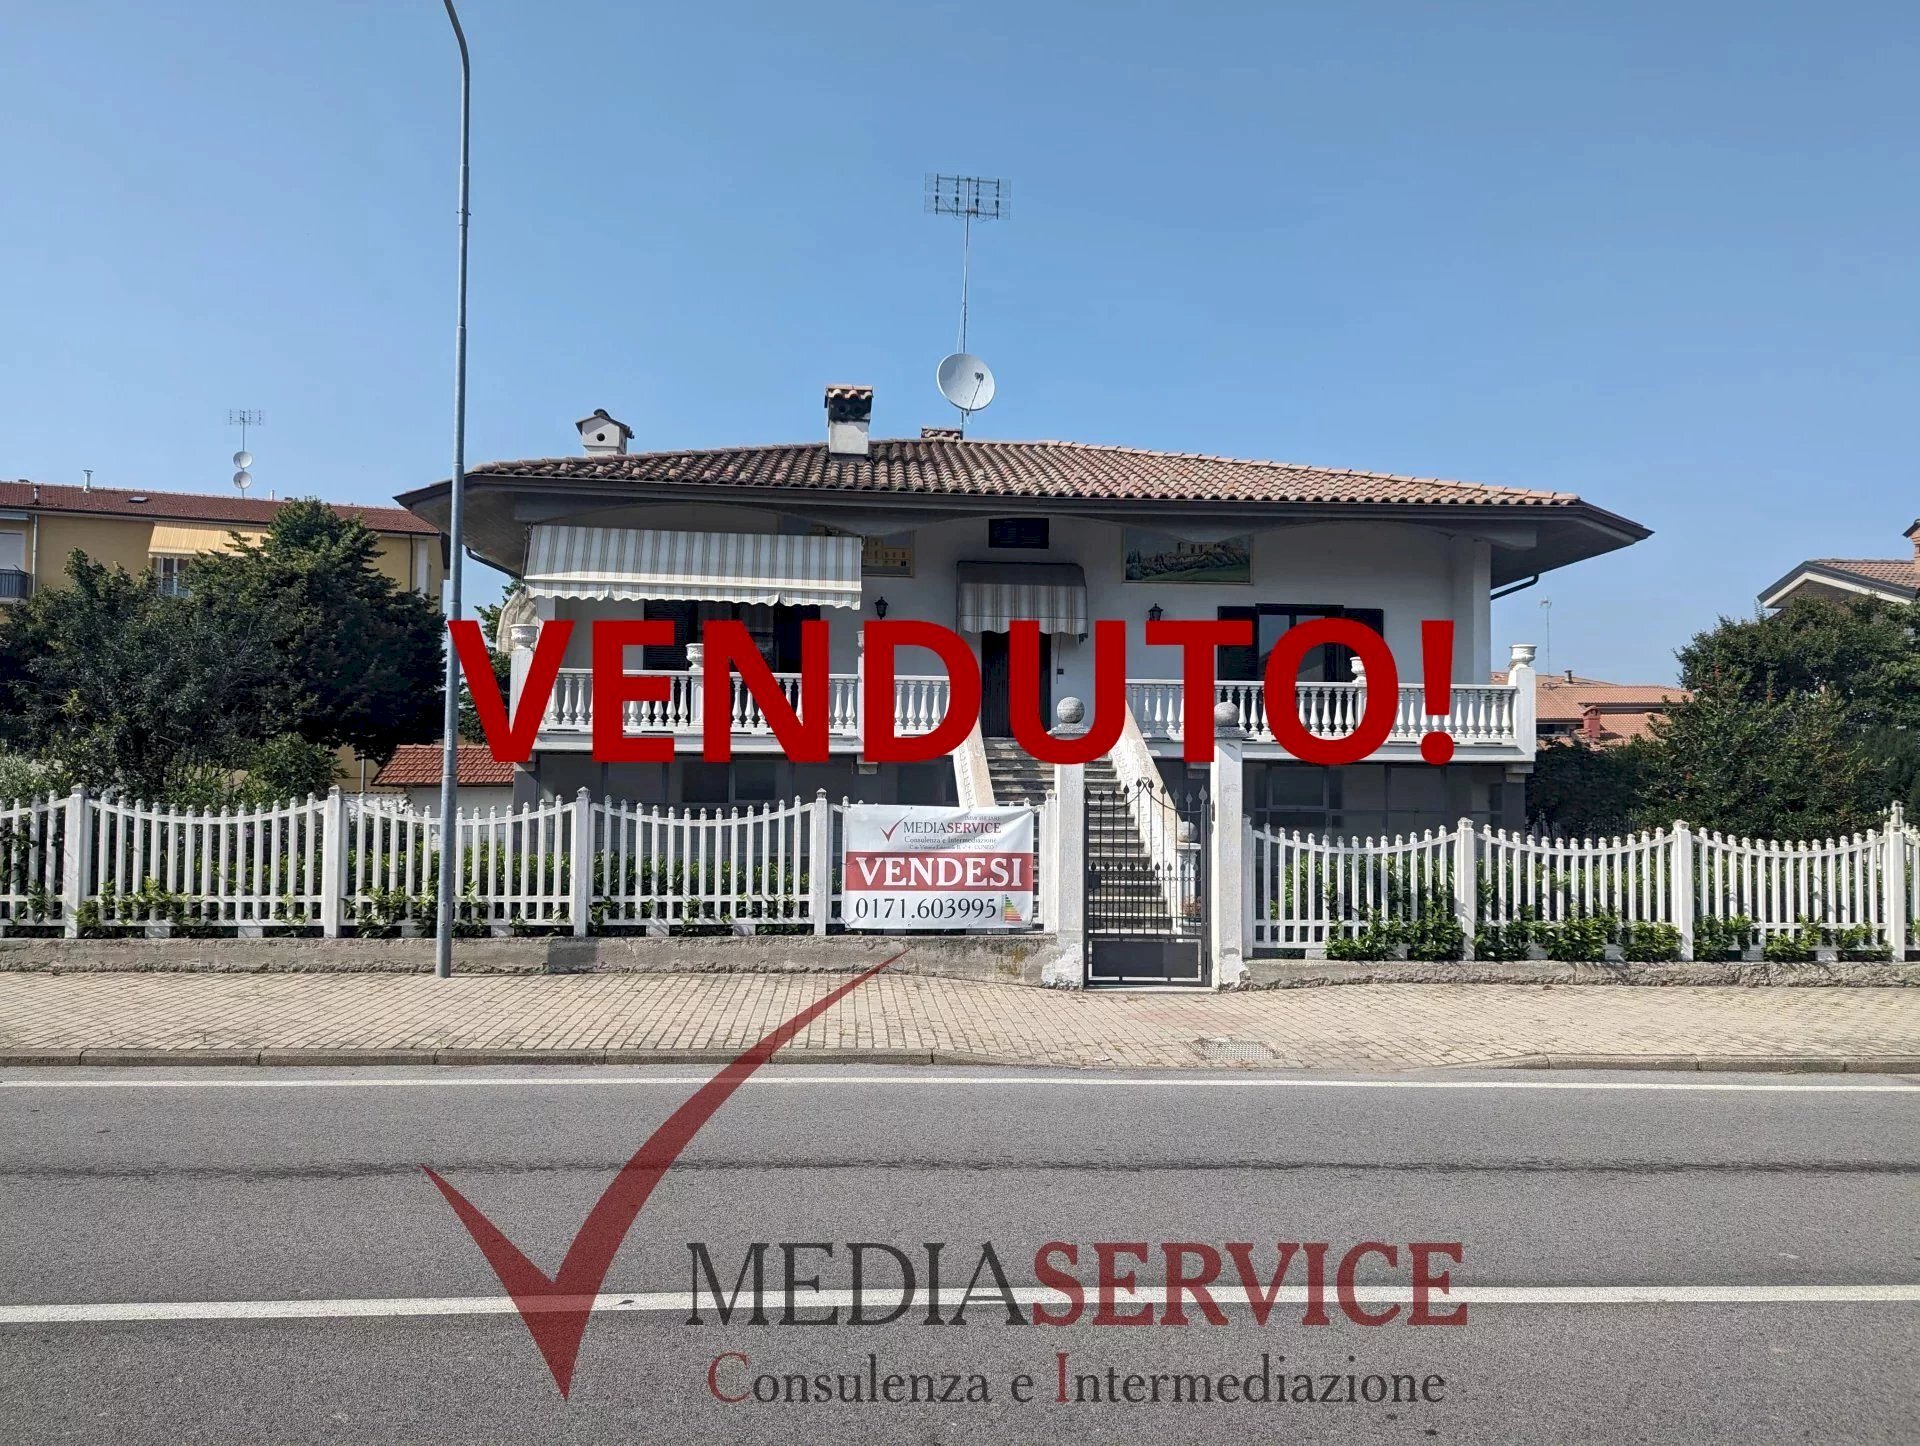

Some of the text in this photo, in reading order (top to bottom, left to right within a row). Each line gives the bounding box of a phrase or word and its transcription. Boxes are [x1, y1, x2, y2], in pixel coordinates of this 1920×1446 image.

[903, 821, 1002, 834] MEDIASERVICE
[904, 836, 940, 844] Consulenza
[947, 836, 997, 844] Intermediazione
[855, 857, 1022, 887] VENDESI
[855, 897, 997, 919] 0171.603995
